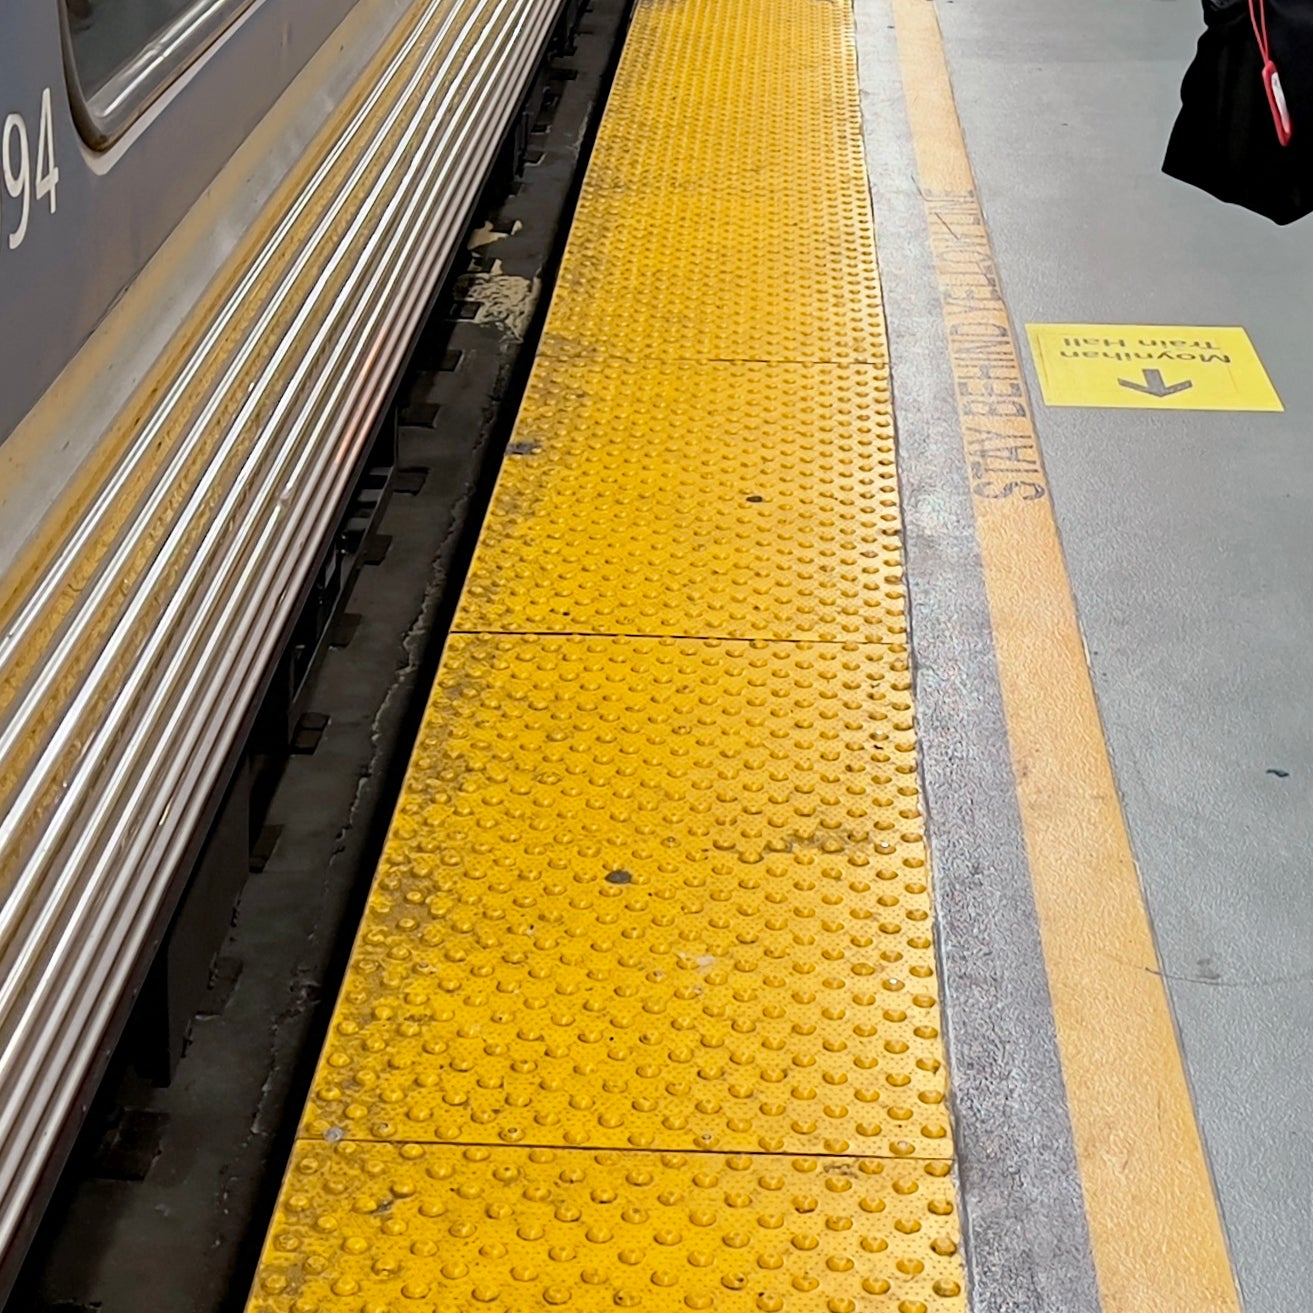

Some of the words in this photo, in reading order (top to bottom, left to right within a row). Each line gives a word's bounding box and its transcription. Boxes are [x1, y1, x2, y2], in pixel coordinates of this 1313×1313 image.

[1063, 338, 1125, 348] Hall
[1138, 338, 1221, 350] Train
[1060, 350, 1231, 364] Moynihan
[949, 322, 1027, 417] BEHIND
[964, 427, 1046, 501] STAY
